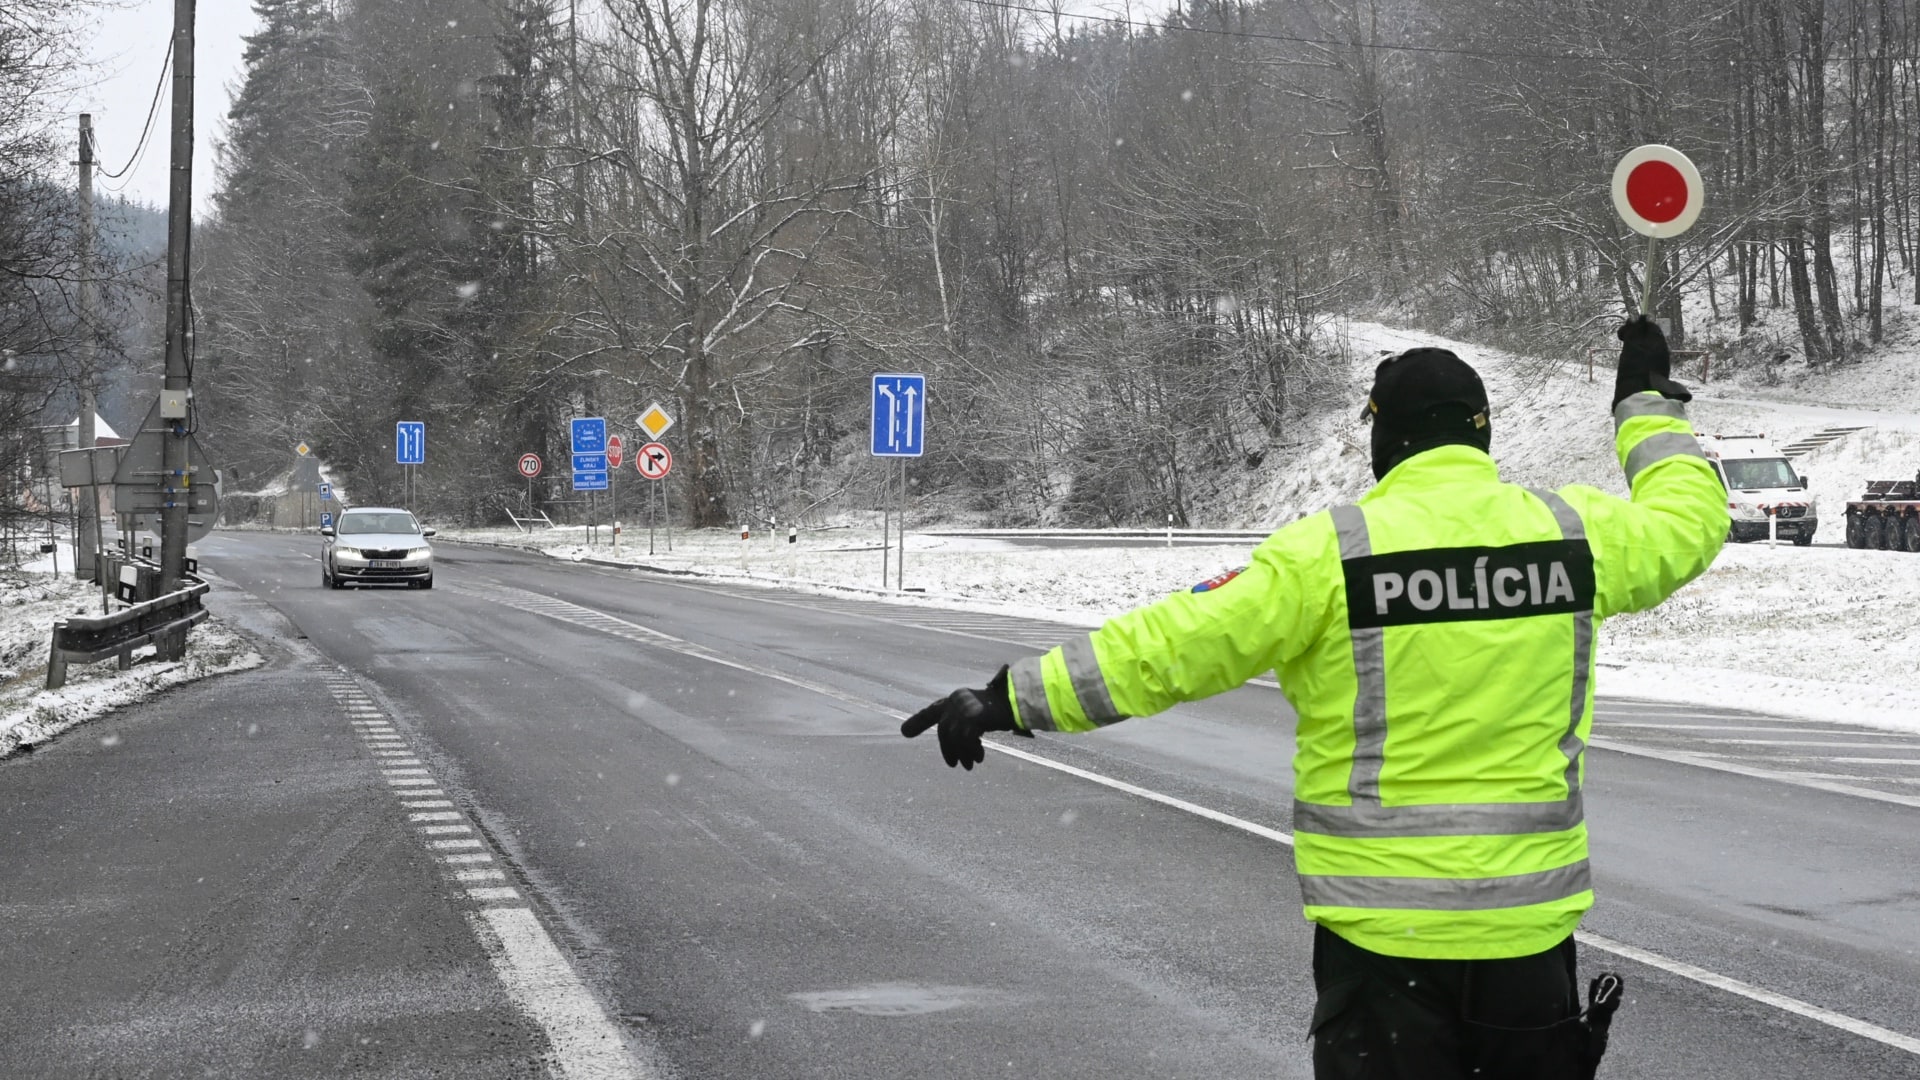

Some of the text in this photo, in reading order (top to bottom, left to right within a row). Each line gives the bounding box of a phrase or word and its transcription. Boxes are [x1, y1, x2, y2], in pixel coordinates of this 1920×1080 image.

[609, 445, 621, 458] STOP
[523, 460, 537, 471] 70
[322, 514, 329, 524] P
[1372, 556, 1575, 615] POLÍCIA
